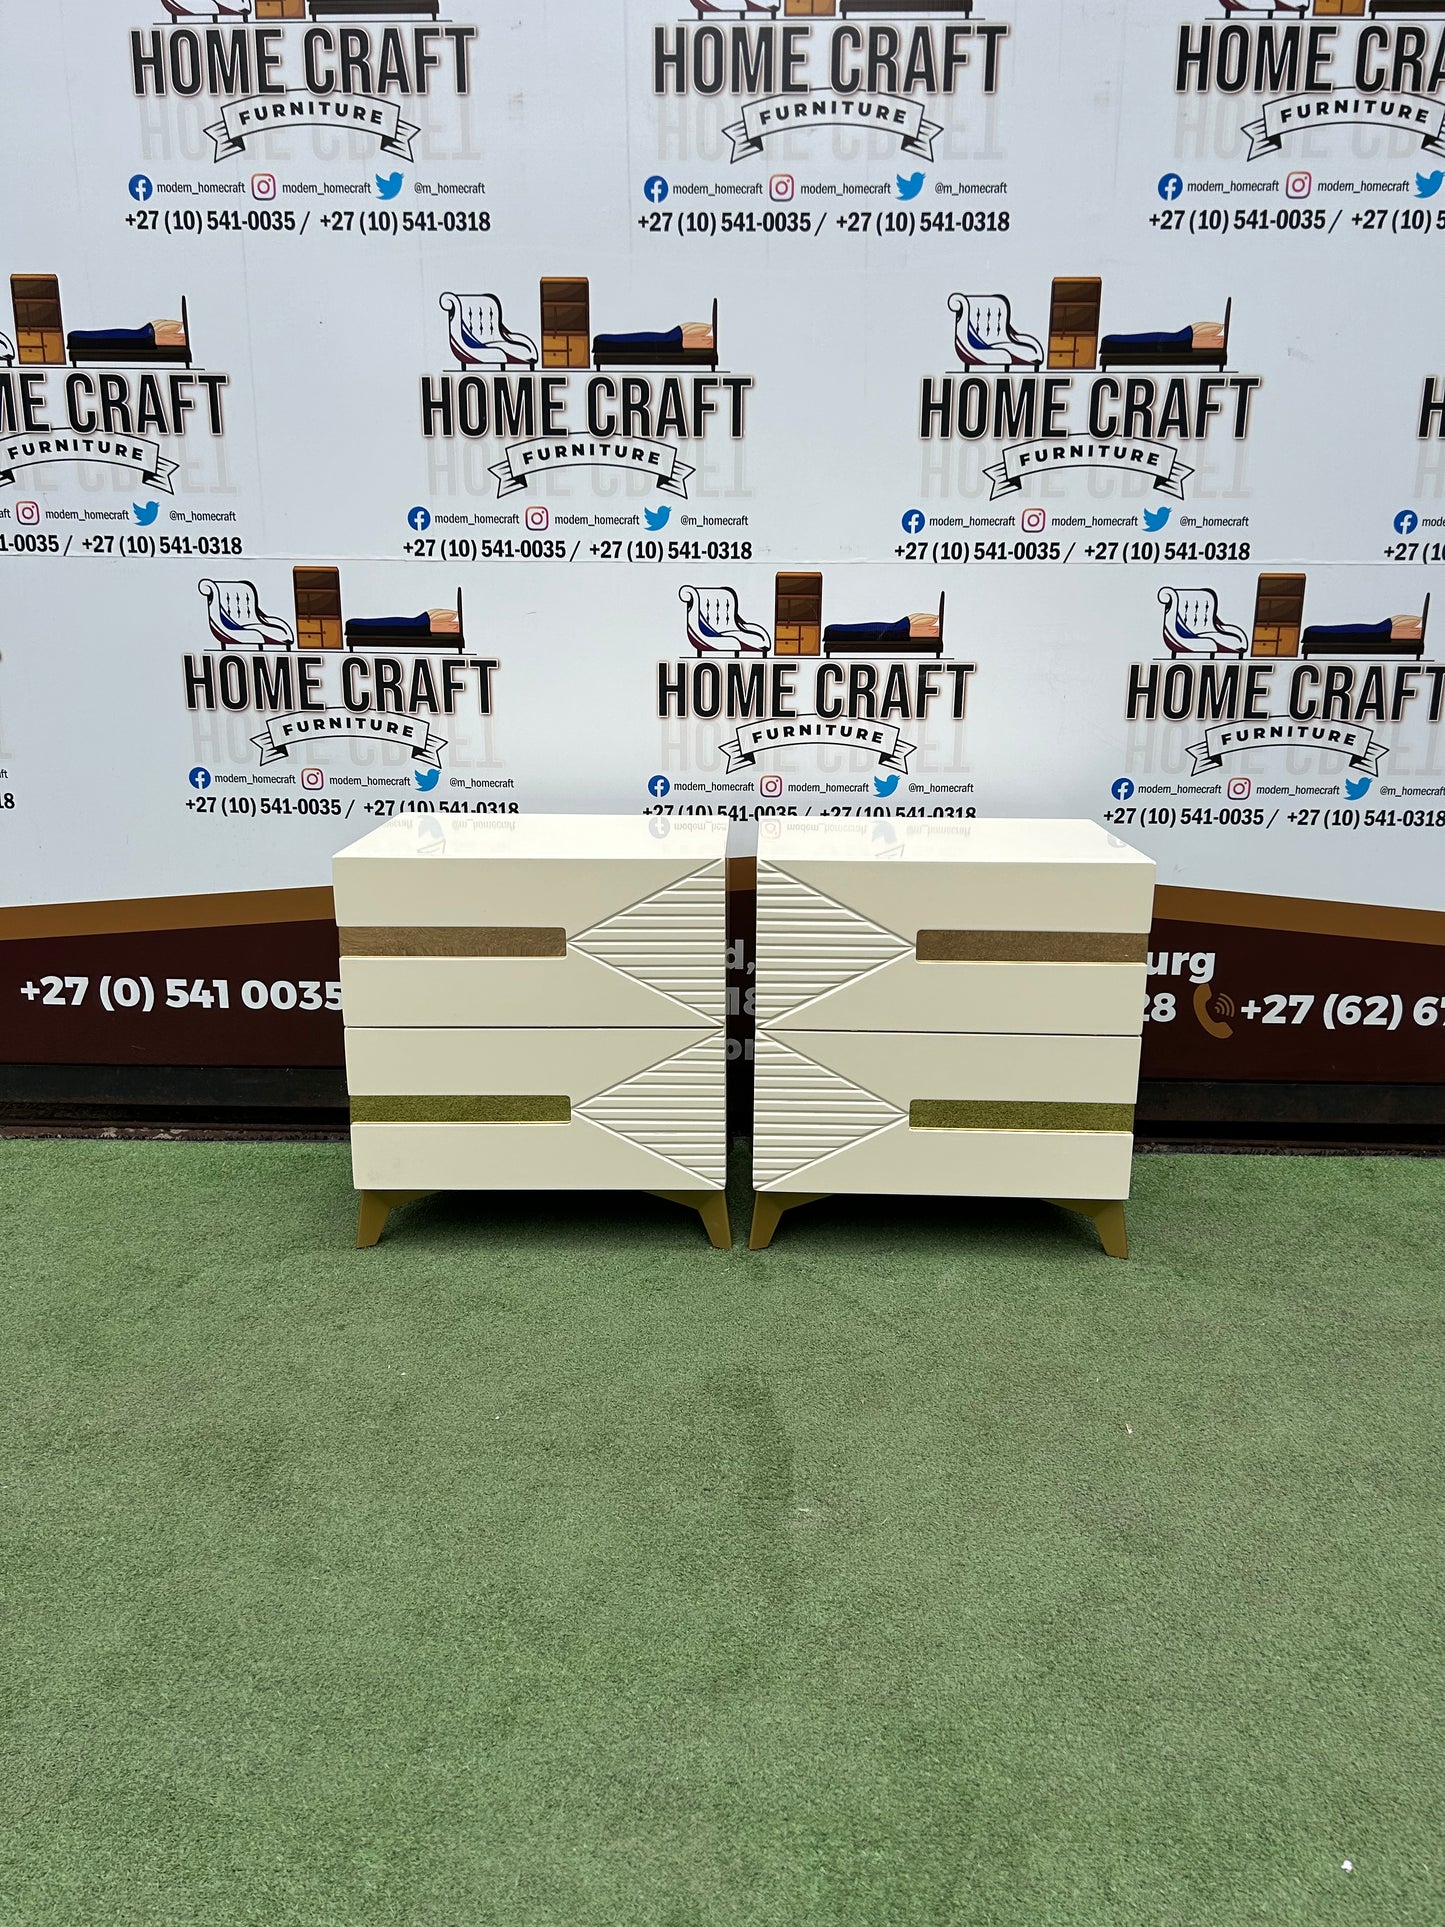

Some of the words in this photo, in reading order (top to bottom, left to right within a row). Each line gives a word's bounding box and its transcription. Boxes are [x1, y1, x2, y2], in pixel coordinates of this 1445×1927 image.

[130, 28, 285, 98] HOME
[303, 27, 478, 98] CRAFT
[654, 25, 810, 95] HOME
[830, 25, 1011, 96] CRAFT
[1176, 24, 1340, 96] HOME
[238, 101, 383, 126] FURNITURE
[759, 100, 907, 126] FURNITURE
[1280, 99, 1430, 124] FURNITURE
[413, 181, 486, 197] @m_homecraft
[934, 181, 1008, 197] @m_homecraft
[125, 209, 159, 230] +27
[164, 209, 203, 235] (10)
[207, 210, 296, 231] 541-0035
[319, 210, 355, 231] +27
[359, 210, 398, 236] (10)
[402, 211, 491, 232] 541-0318
[637, 211, 673, 232] +27
[677, 211, 717, 237] (10)
[720, 211, 812, 233] 541-0035
[836, 211, 872, 232] +27
[876, 211, 916, 237] (10)
[919, 211, 1010, 233] 541-0318
[1148, 209, 1186, 230] +27
[1189, 209, 1229, 235] (10)
[1233, 209, 1326, 230] 541-0035
[1351, 209, 1389, 230] +27
[1391, 209, 1432, 235] (10)
[65, 372, 230, 437] CRAFT
[421, 376, 569, 440] HOME
[587, 376, 755, 441] CRAFT
[920, 377, 1073, 442] HOME
[1088, 377, 1260, 442] CRAFT
[7, 438, 144, 462] FURNITURE
[522, 443, 661, 466] FURNITURE
[1019, 444, 1160, 467] FURNITURE
[169, 509, 237, 523] @m_homecraft
[680, 514, 749, 528] @m_homecraft
[1179, 515, 1250, 529] @m_homecraft
[81, 534, 115, 554] +27
[119, 535, 156, 558] (10)
[159, 535, 243, 555] 541-0318
[403, 538, 436, 557] +27
[440, 539, 477, 562] (10)
[481, 539, 566, 559] 541-0035
[589, 540, 623, 559] +27
[627, 540, 664, 563] (10)
[667, 541, 753, 560] 541-0318
[894, 541, 929, 560] +27
[932, 541, 970, 564] (10)
[973, 541, 1061, 561] 541-0035
[1084, 541, 1119, 560] +27
[1122, 541, 1160, 565] (10)
[1164, 541, 1251, 561] 541-0318
[1383, 542, 1420, 561] +27
[183, 654, 325, 713] HOME
[341, 656, 500, 717] CRAFT
[658, 662, 800, 721] HOME
[815, 663, 977, 722] CRAFT
[1126, 663, 1276, 723] HOME
[1289, 664, 1445, 724] CRAFT
[282, 717, 414, 738] FURNITURE
[751, 724, 884, 744] FURNITURE
[1220, 725, 1357, 747] FURNITURE
[449, 777, 515, 790] @m_homecraft
[908, 782, 975, 795] @m_homecraft
[1379, 785, 1445, 798] @m_homecraft
[185, 796, 217, 813] +27
[221, 796, 257, 818] (10)
[260, 797, 342, 816] 541-0035
[363, 799, 396, 817] +27
[1103, 807, 1137, 825] +27
[1140, 807, 1177, 829] (10)
[1179, 807, 1264, 826] 541-0035
[1286, 808, 1321, 826] +27
[1323, 809, 1360, 830] (10)
[1363, 809, 1445, 828] 541-0318
[20, 975, 89, 1006] +27
[99, 975, 155, 1013] (0)
[165, 978, 230, 1009] 541
[240, 978, 344, 1012] 0035
[1240, 994, 1315, 1025] +27
[1323, 993, 1403, 1031] (62)
[1412, 996, 1445, 1027] 6
